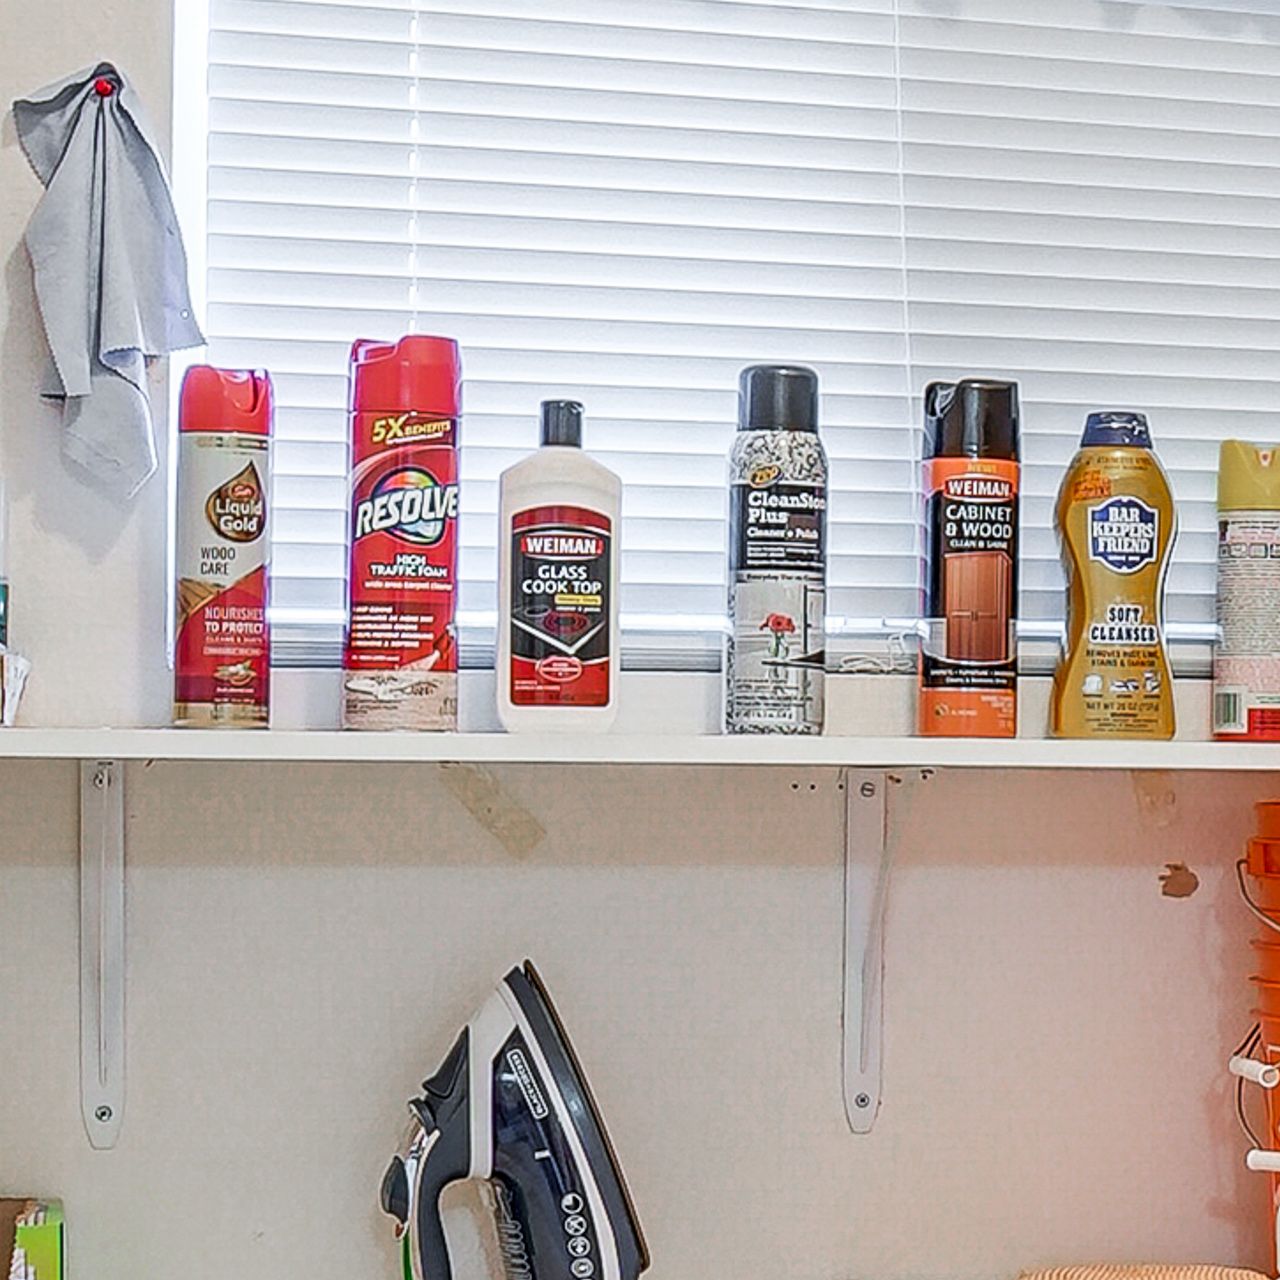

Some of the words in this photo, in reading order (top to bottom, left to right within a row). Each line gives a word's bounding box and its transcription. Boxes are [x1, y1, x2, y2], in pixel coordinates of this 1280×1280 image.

[372, 414, 406, 442] 5X
[948, 480, 1010, 497] WEIMAN
[215, 498, 262, 516] Liquid
[354, 485, 458, 538] RESOLVE
[946, 505, 1013, 521] CABINET
[1109, 507, 1139, 522] BAR
[219, 515, 258, 532] Gold
[748, 508, 788, 523] Plus
[945, 522, 958, 537] &
[962, 522, 1013, 539] WOOD
[1093, 521, 1154, 538] KEEPERS
[526, 537, 596, 554] WEIMAN
[1098, 536, 1150, 553] FRIEND
[200, 547, 236, 560] WOOD
[200, 562, 229, 575] CARE
[538, 565, 588, 579] GLASS
[522, 580, 569, 595] COOK
[570, 581, 602, 594] TOP
[1109, 607, 1140, 622] SOFT
[204, 621, 219, 633] TO
[221, 621, 263, 634] PROTECT
[1091, 626, 1155, 642] CLEANSER
